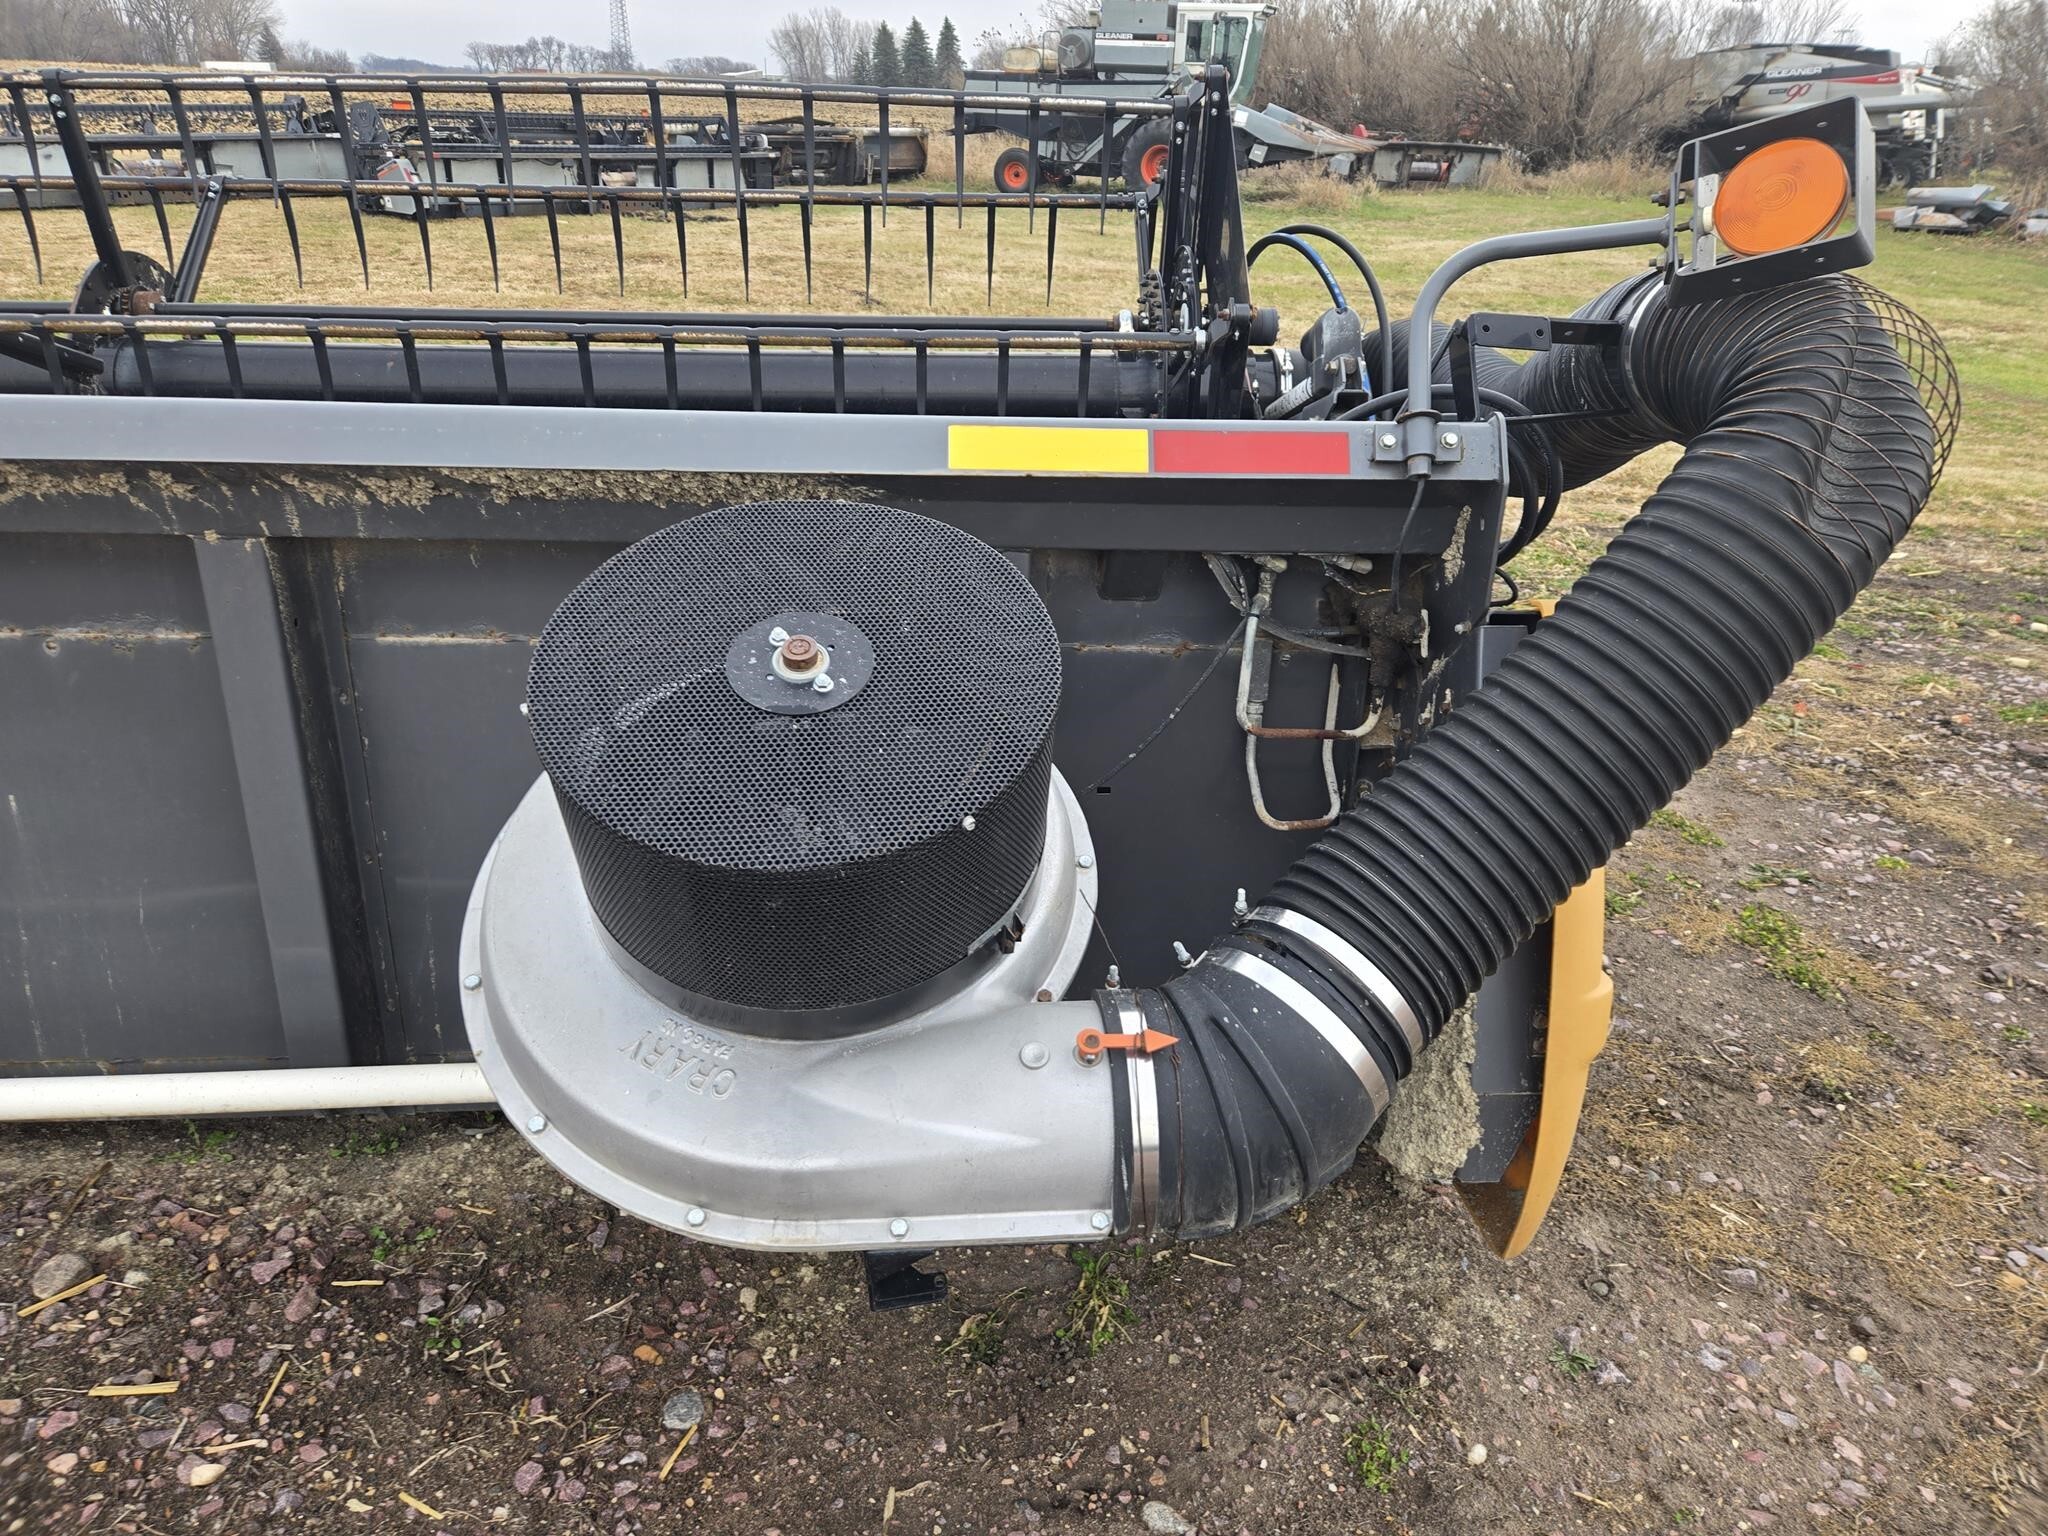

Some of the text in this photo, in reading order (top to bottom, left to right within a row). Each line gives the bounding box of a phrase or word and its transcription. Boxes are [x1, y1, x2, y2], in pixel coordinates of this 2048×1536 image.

[1767, 67, 1822, 78] GLEANER
[1784, 84, 1813, 104] 90
[617, 1031, 736, 1099] CRARY
